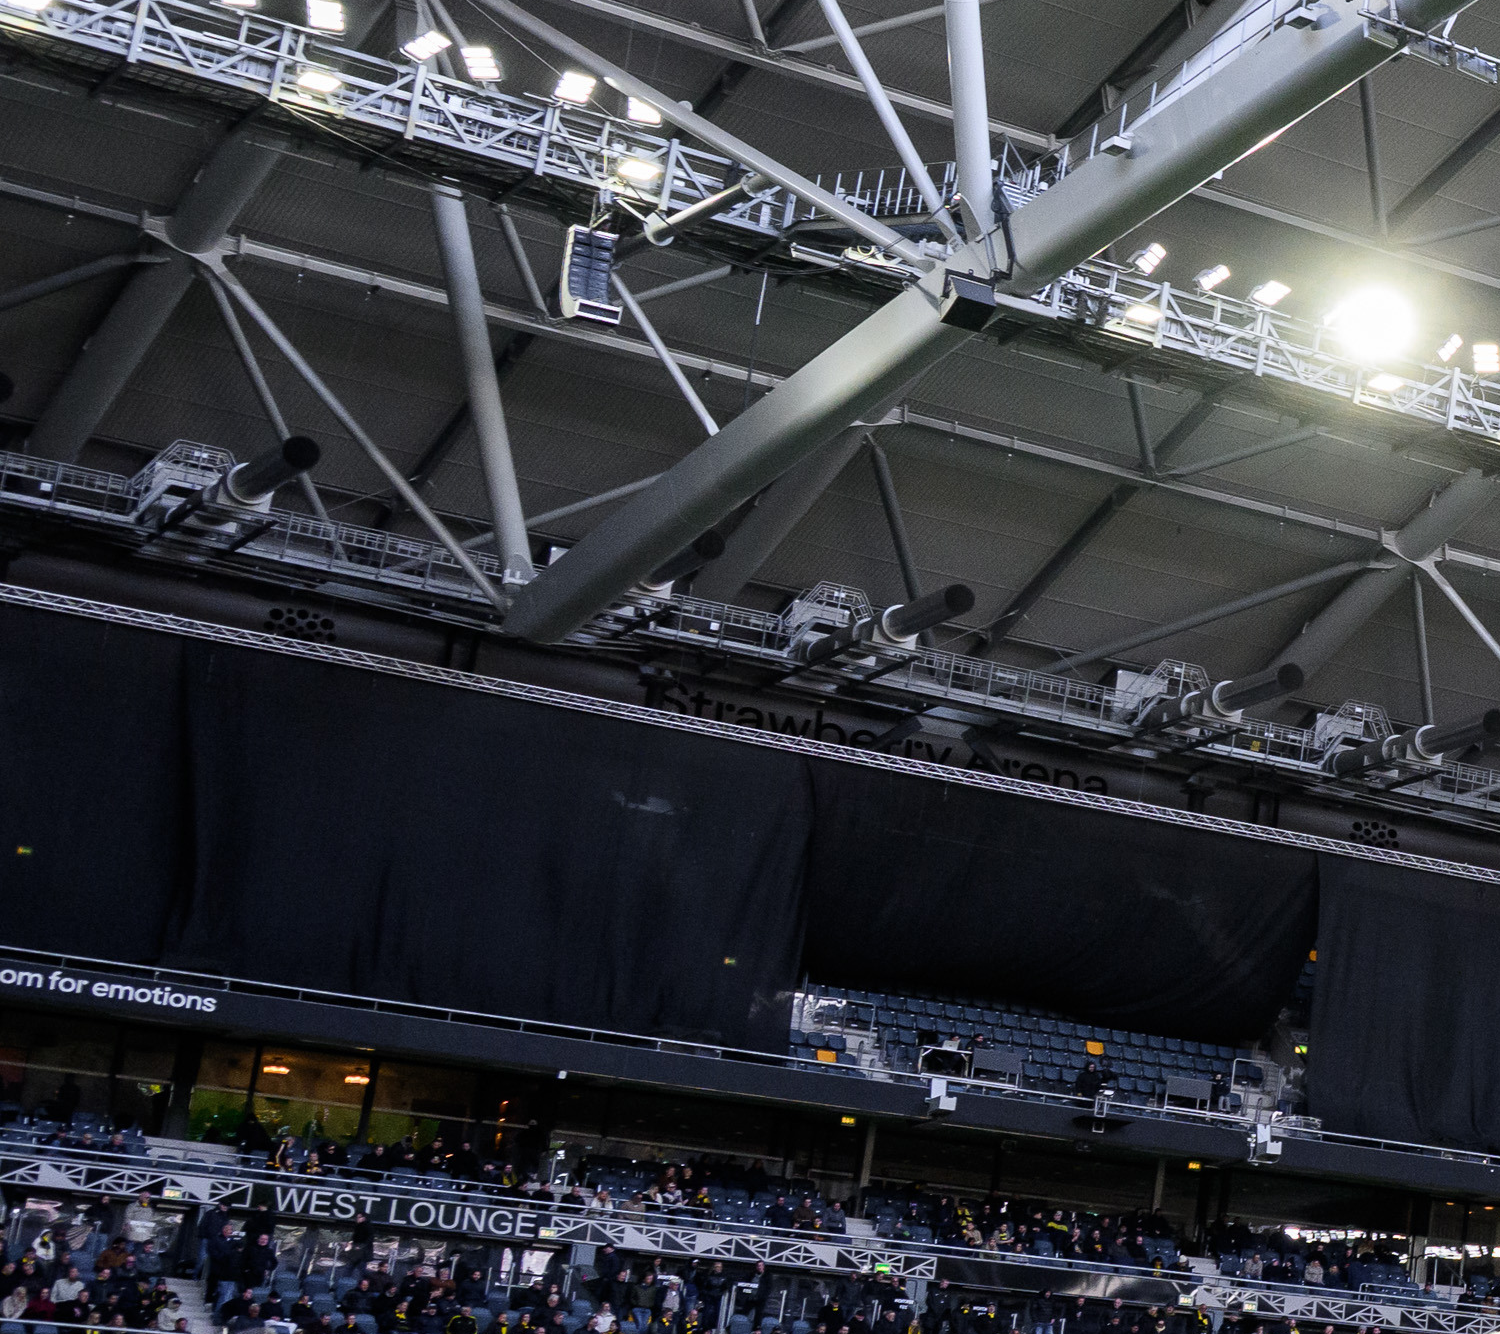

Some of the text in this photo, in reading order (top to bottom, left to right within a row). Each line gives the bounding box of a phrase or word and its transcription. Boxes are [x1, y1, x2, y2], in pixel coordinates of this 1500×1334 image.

[49, 970, 89, 994] for
[91, 980, 217, 1013] emotions
[276, 1186, 537, 1239] WEST LOUNGE
